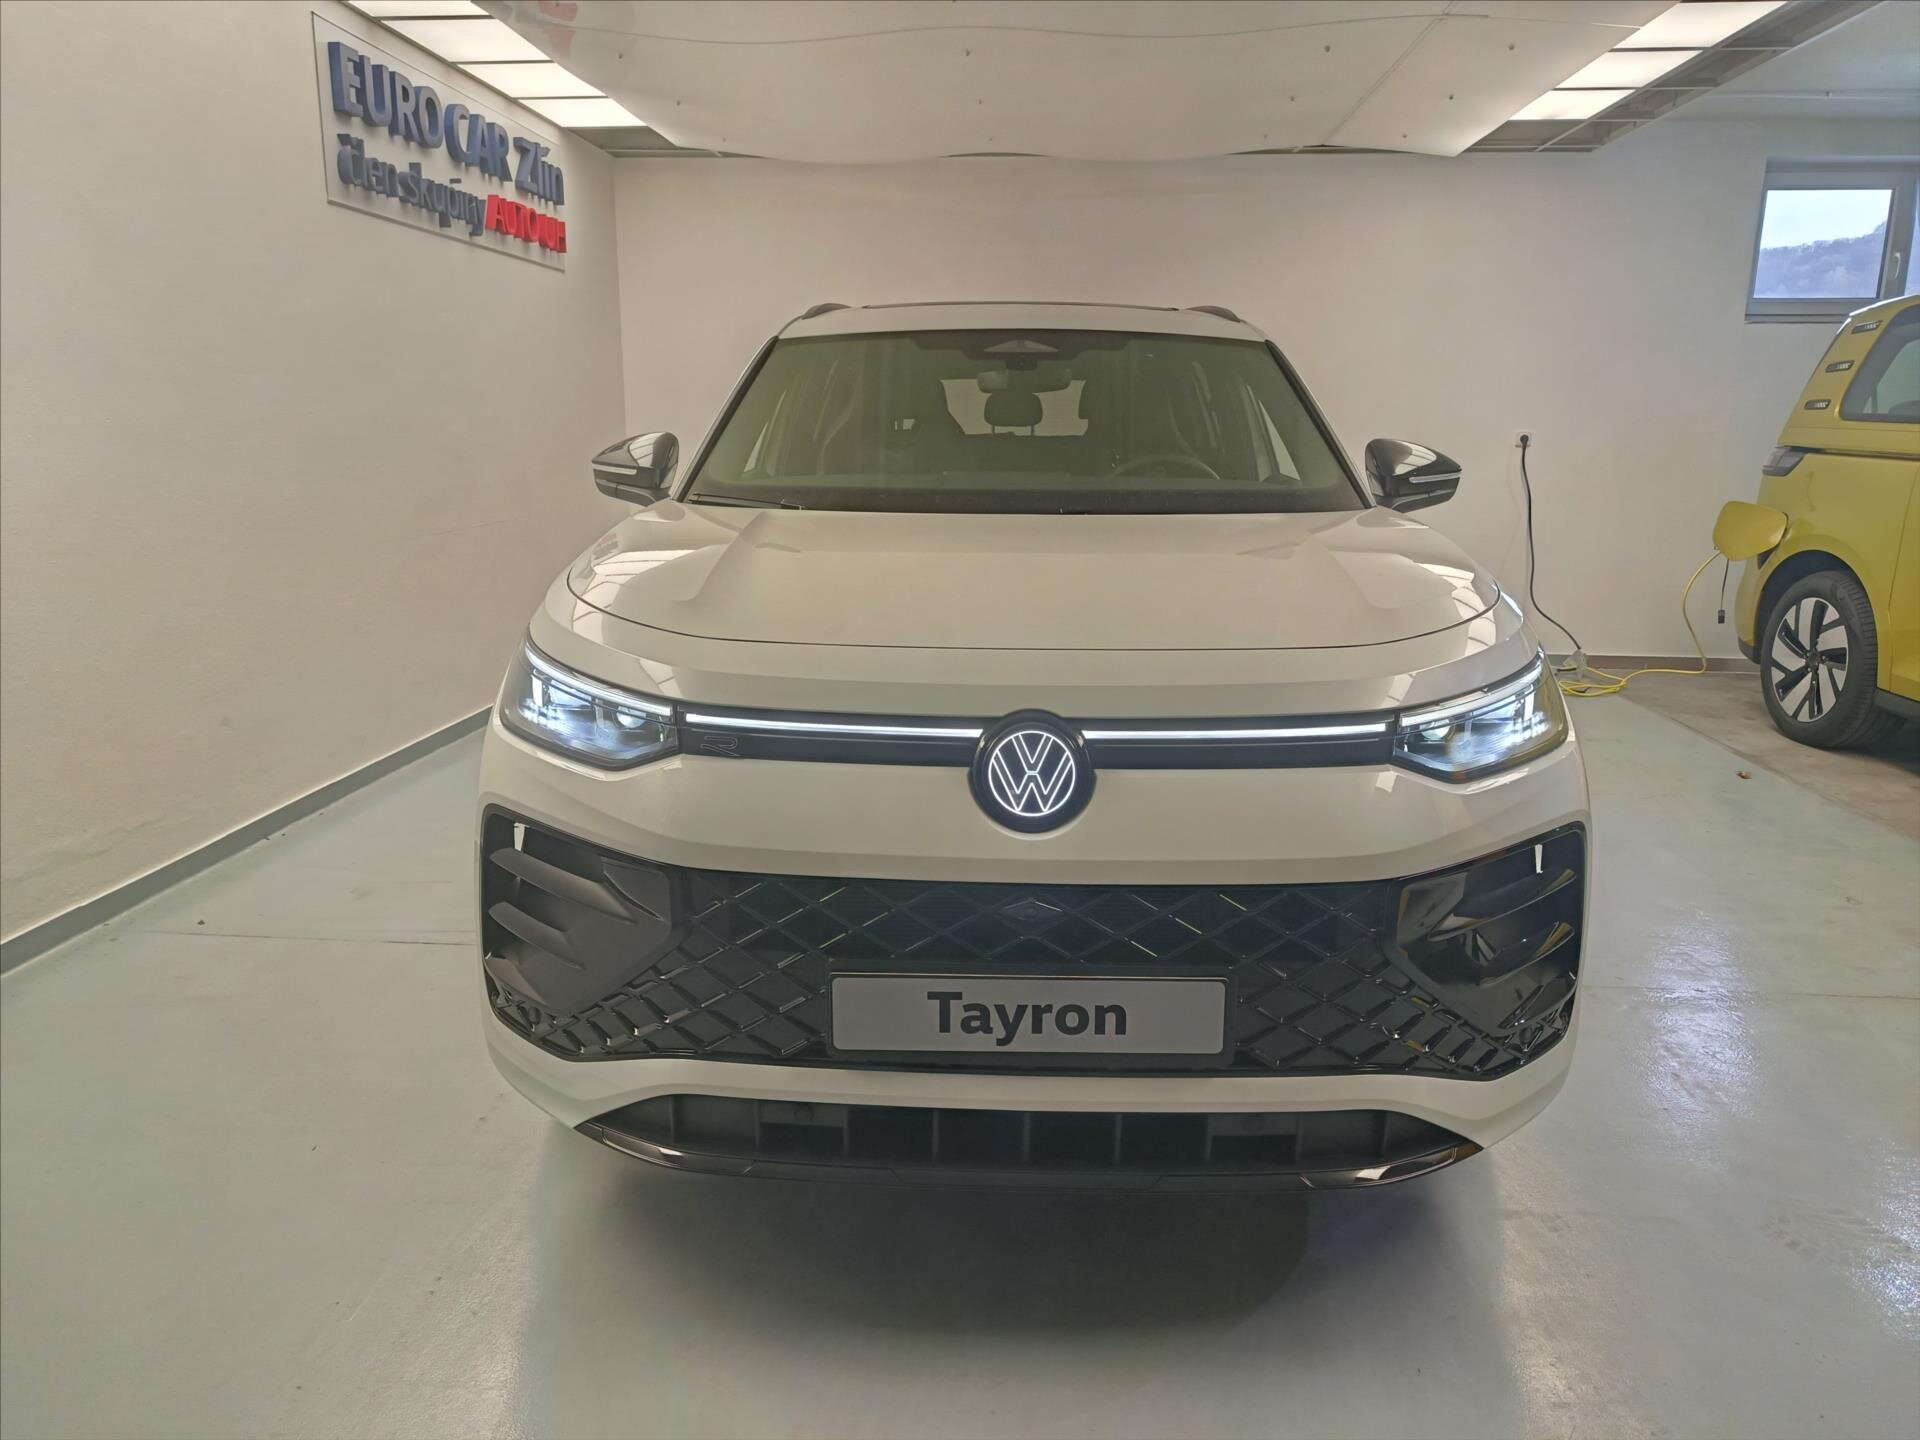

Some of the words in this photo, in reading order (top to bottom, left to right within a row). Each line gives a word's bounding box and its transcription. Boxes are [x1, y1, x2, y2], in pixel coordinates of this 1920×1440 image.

[337, 133, 399, 198] člen
[398, 162, 487, 236] skupiny
[513, 136, 565, 206] Zlín
[927, 991, 1127, 1046] Tayron
